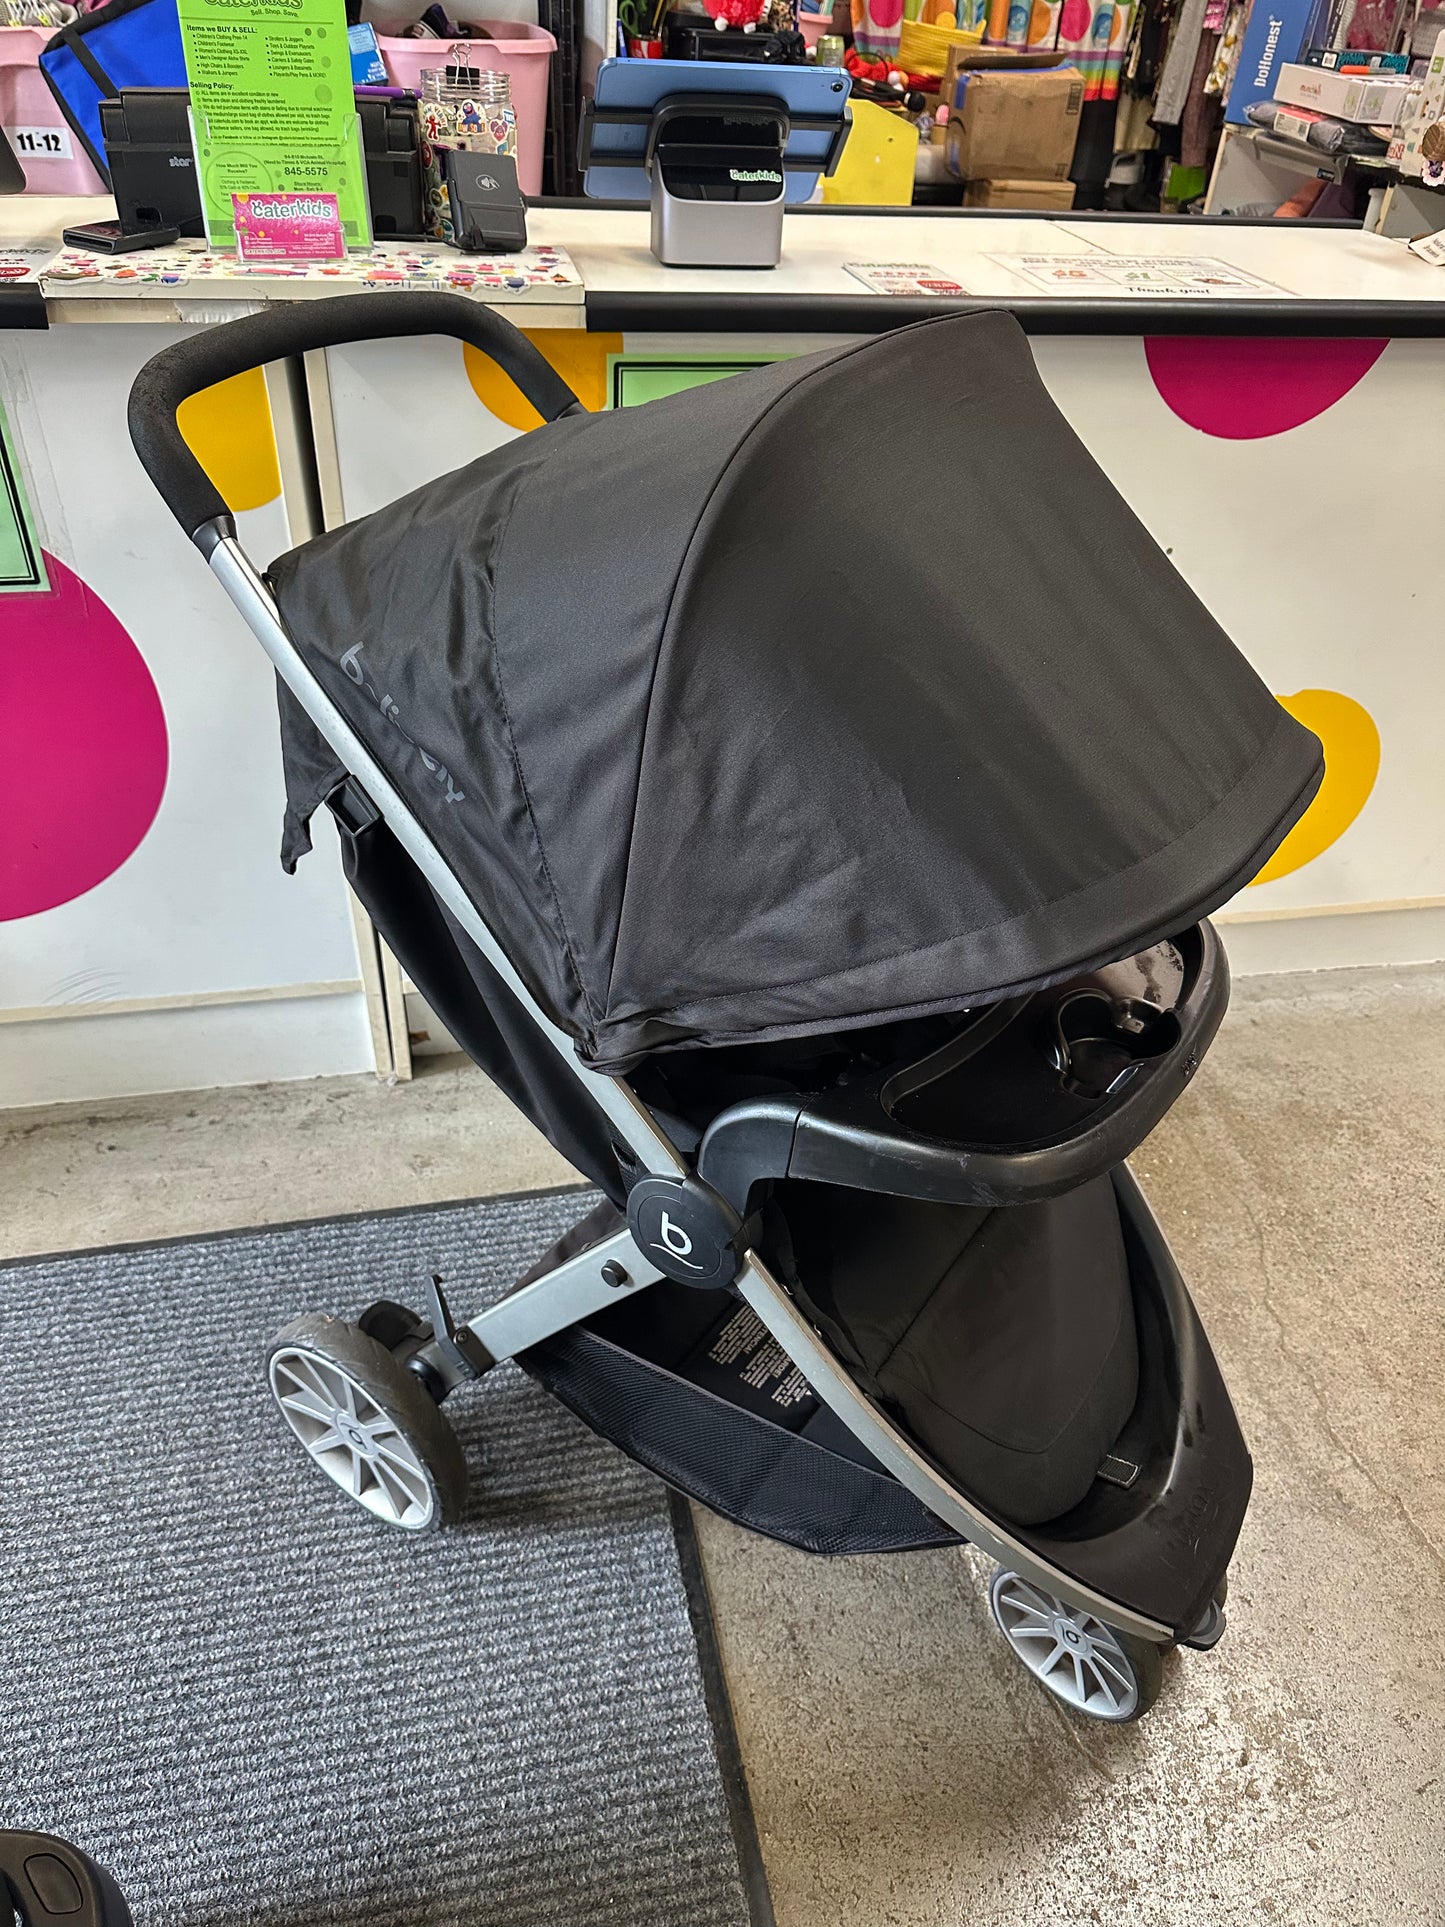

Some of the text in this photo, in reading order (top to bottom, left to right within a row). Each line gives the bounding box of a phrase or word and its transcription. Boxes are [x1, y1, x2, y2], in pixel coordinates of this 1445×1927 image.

[1253, 19, 1283, 87] DoHonest
[190, 81, 235, 90] Selling Policy:
[16, 134, 62, 151] 11-12
[169, 156, 190, 167] star
[284, 166, 328, 176] 845-5575
[252, 200, 331, 218] Caterkids
